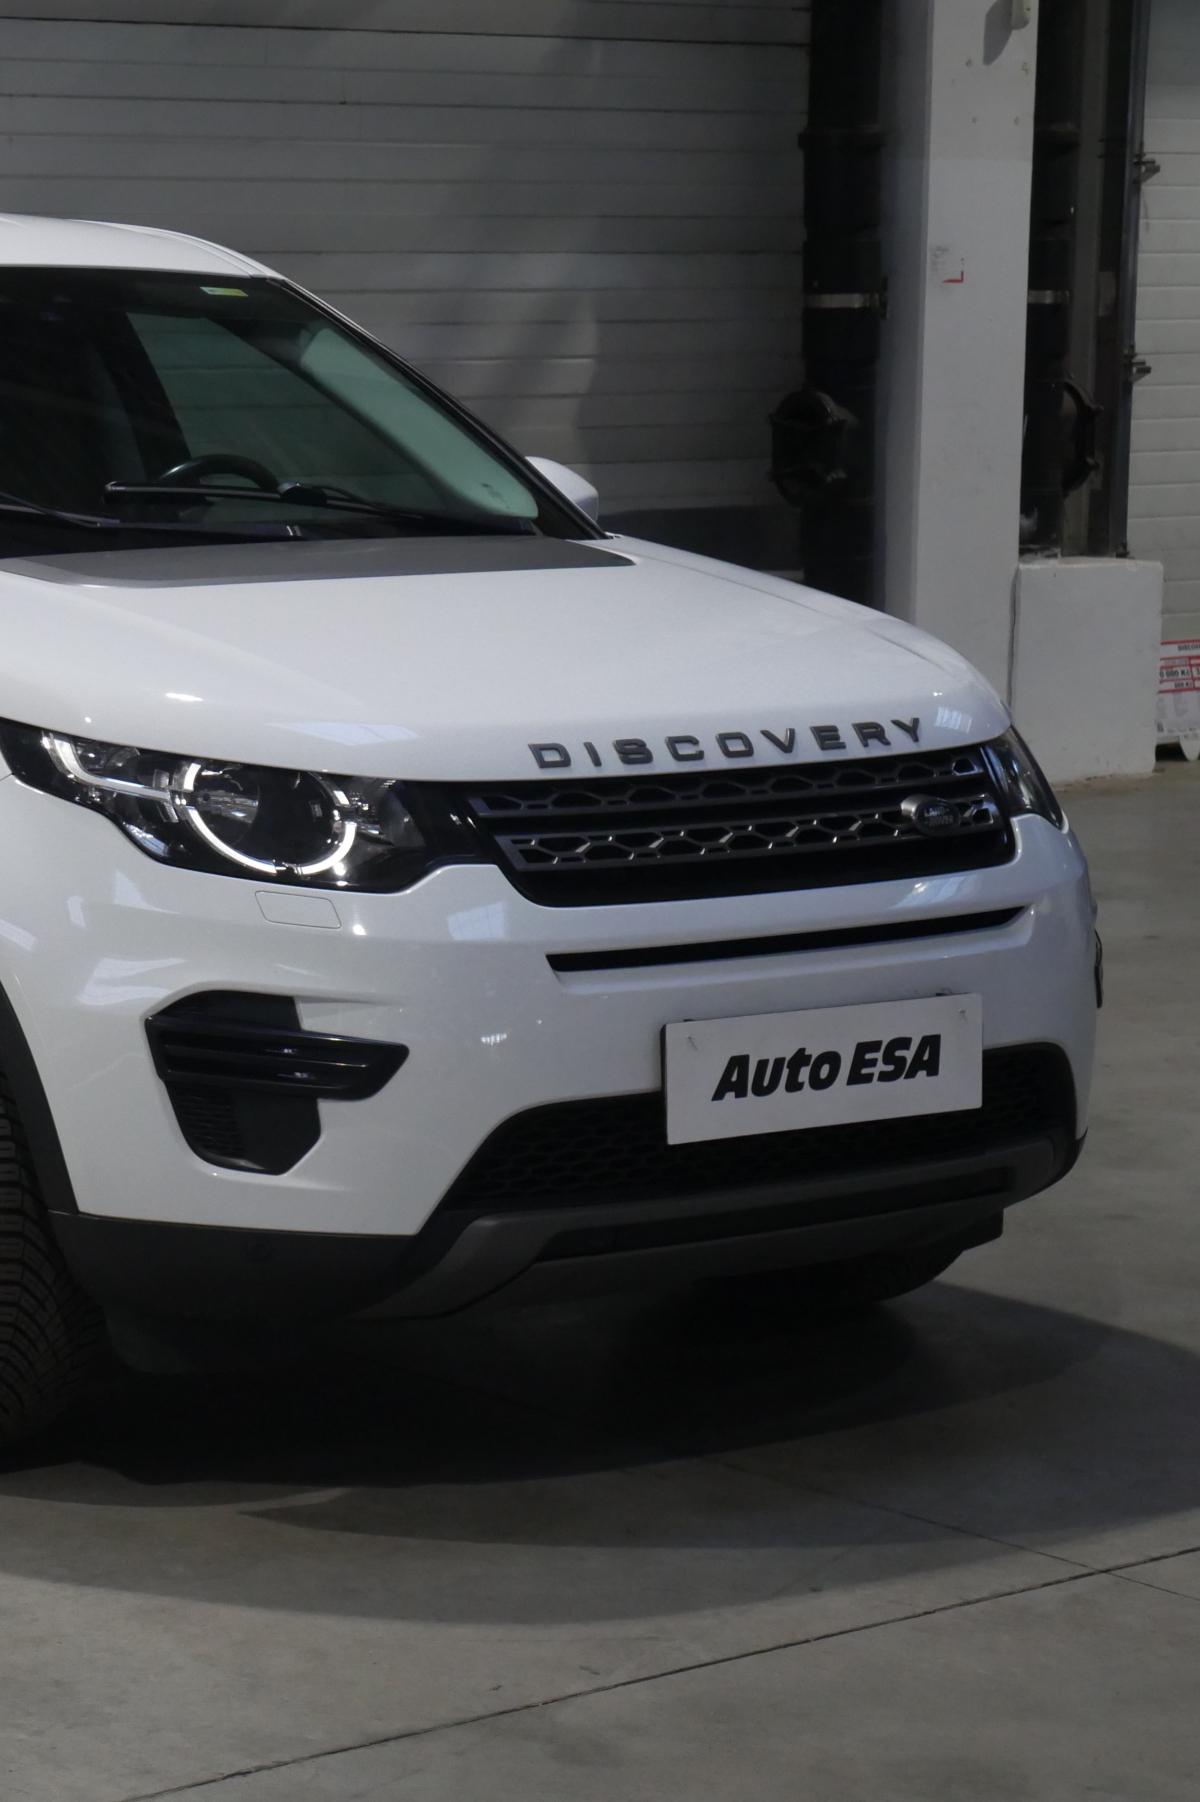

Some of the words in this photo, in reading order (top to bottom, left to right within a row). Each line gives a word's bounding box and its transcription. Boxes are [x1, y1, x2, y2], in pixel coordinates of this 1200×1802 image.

[527, 716, 921, 769] DISCOVERY
[711, 1047, 842, 1101] Auto
[846, 1034, 942, 1086] ESA
